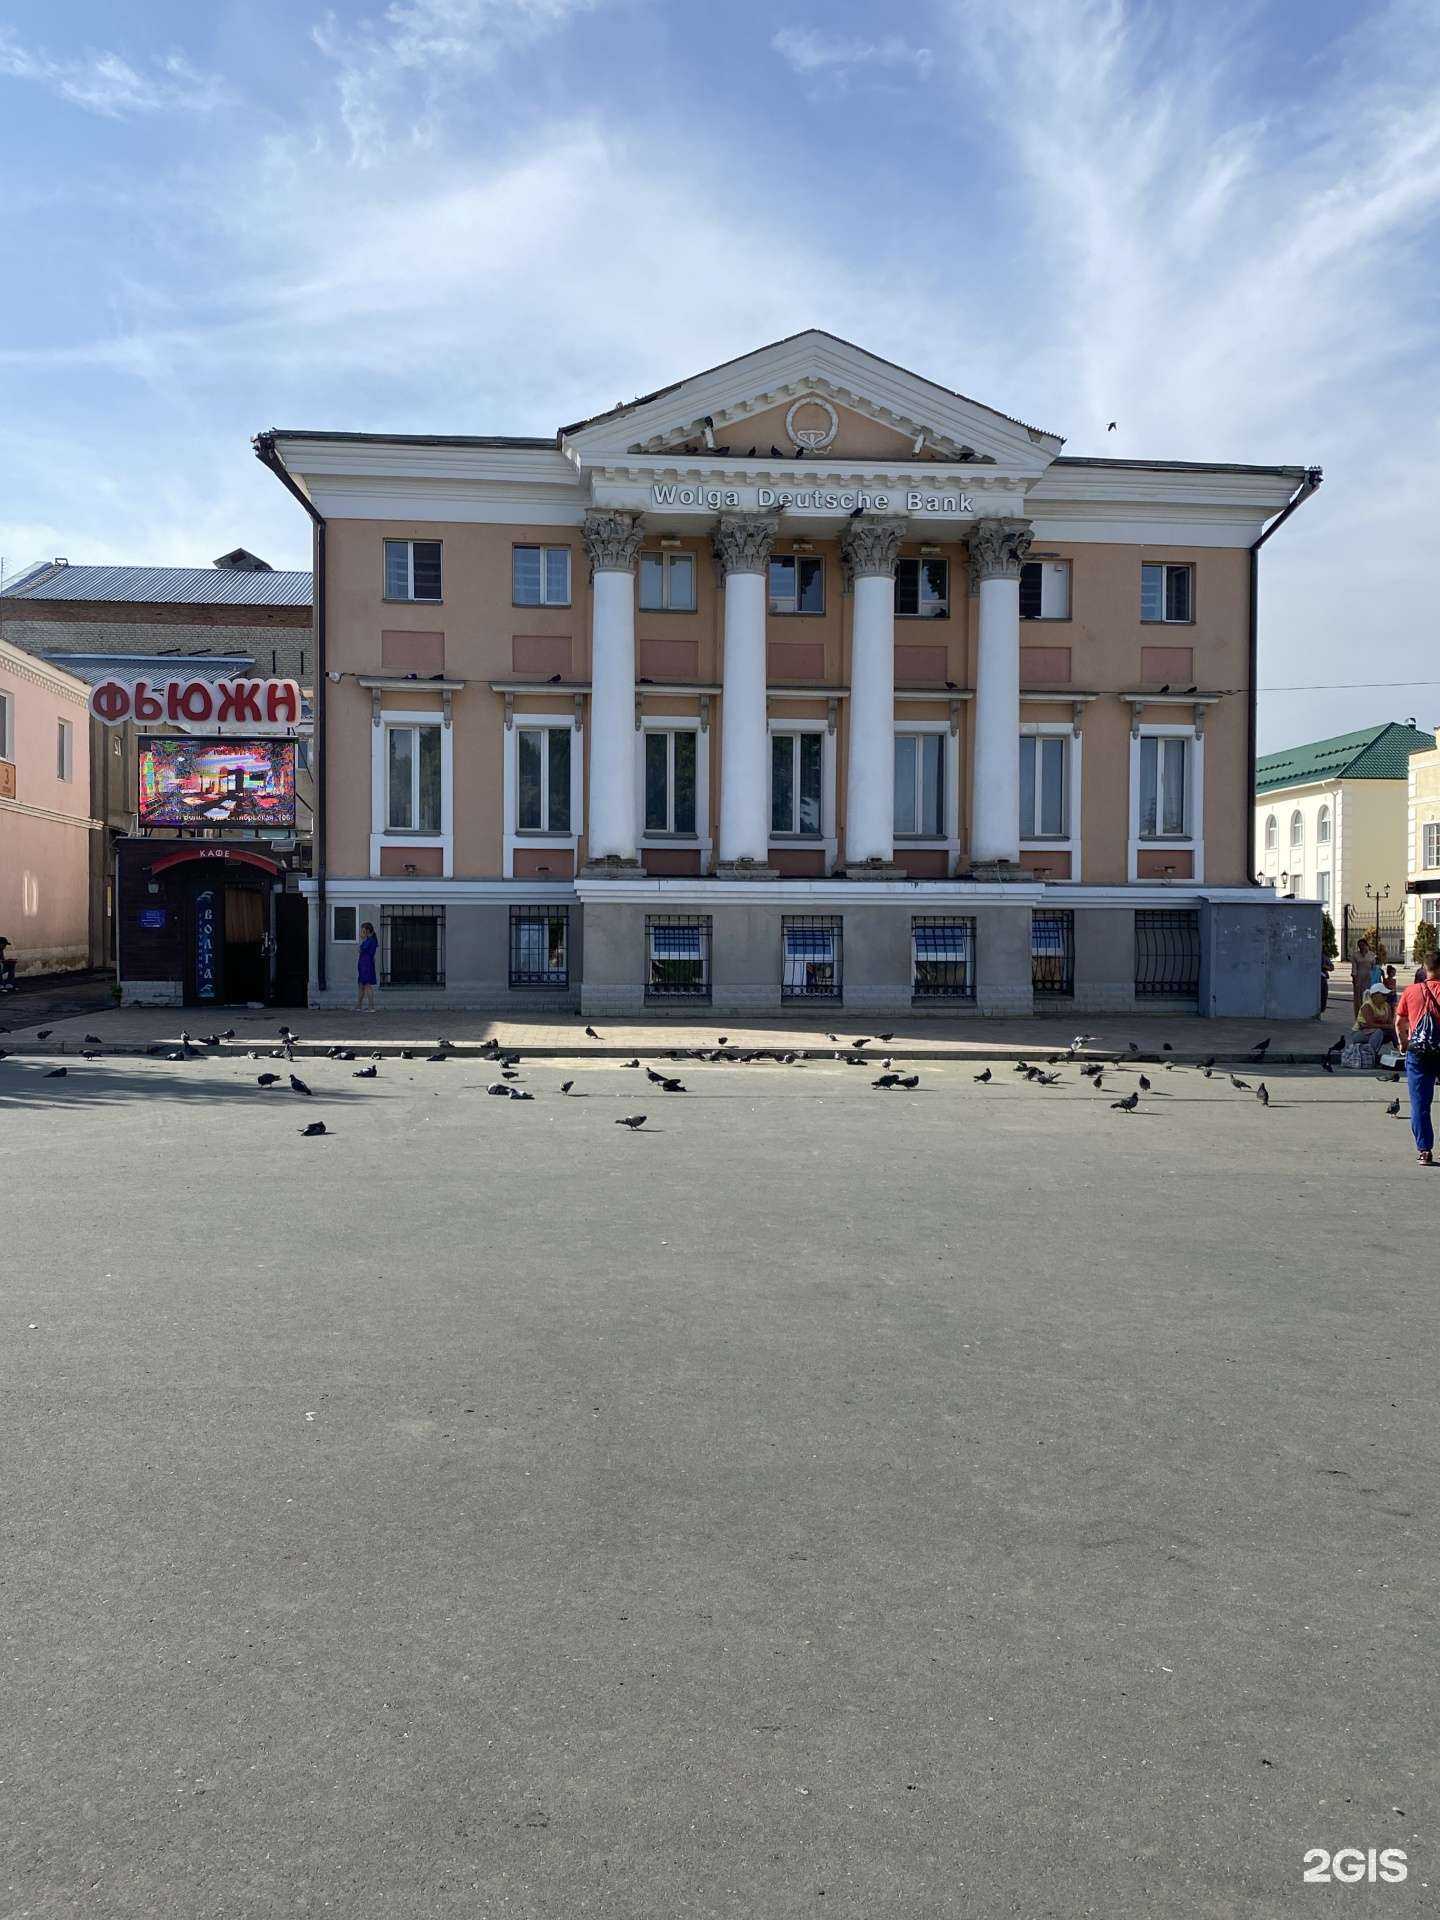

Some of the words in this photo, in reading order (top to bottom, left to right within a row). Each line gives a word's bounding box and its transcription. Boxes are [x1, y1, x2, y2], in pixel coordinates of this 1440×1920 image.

[652, 485, 739, 510] Wolga
[757, 487, 889, 511] Deutsche
[906, 490, 977, 512] Bank
[92, 681, 297, 723] ФЬЮЖН
[199, 849, 231, 858] КАФЕ
